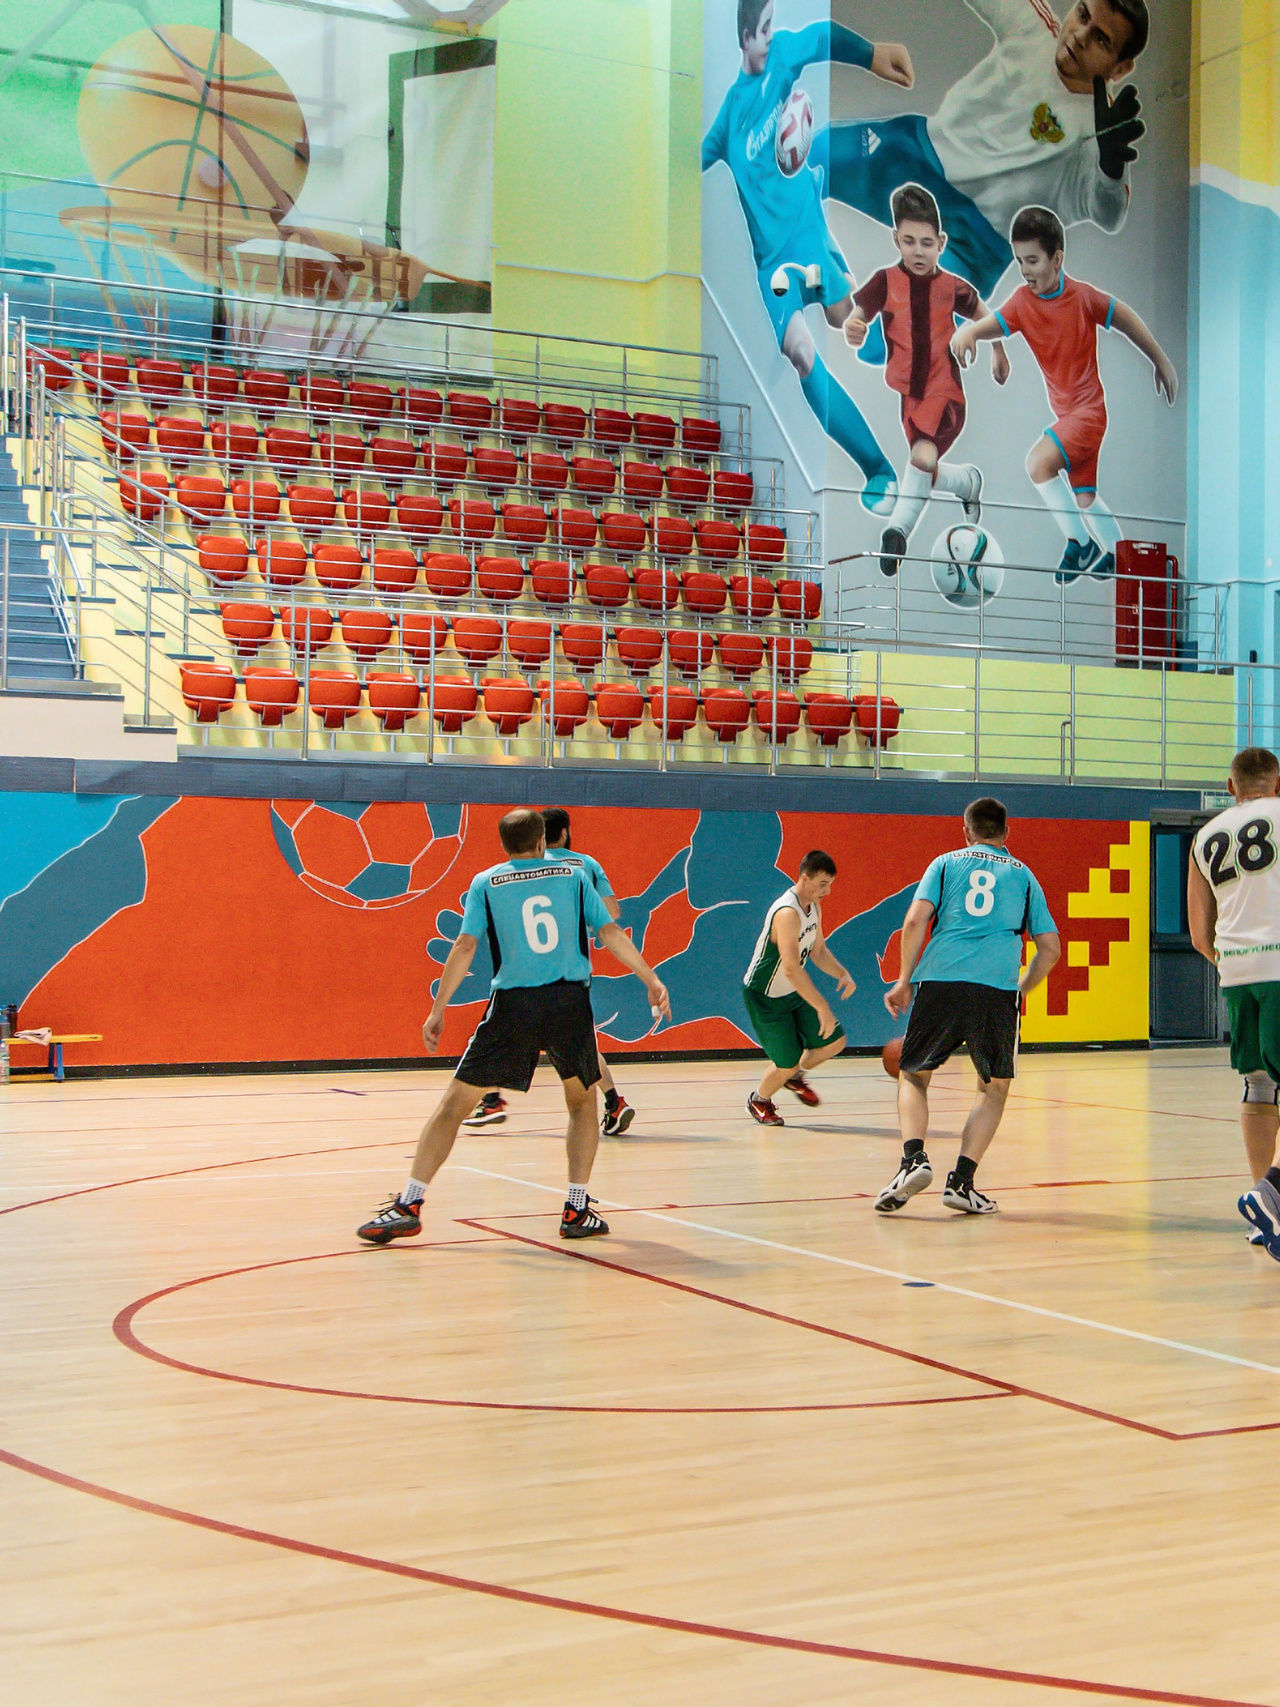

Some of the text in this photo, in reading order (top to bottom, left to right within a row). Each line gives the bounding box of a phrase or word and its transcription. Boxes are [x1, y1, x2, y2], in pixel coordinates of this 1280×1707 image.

[493, 868, 571, 885] СПЕЦАВТОМАТИКА
[1203, 819, 1275, 886] 28
[965, 869, 996, 917] 8
[522, 895, 559, 954] 6
